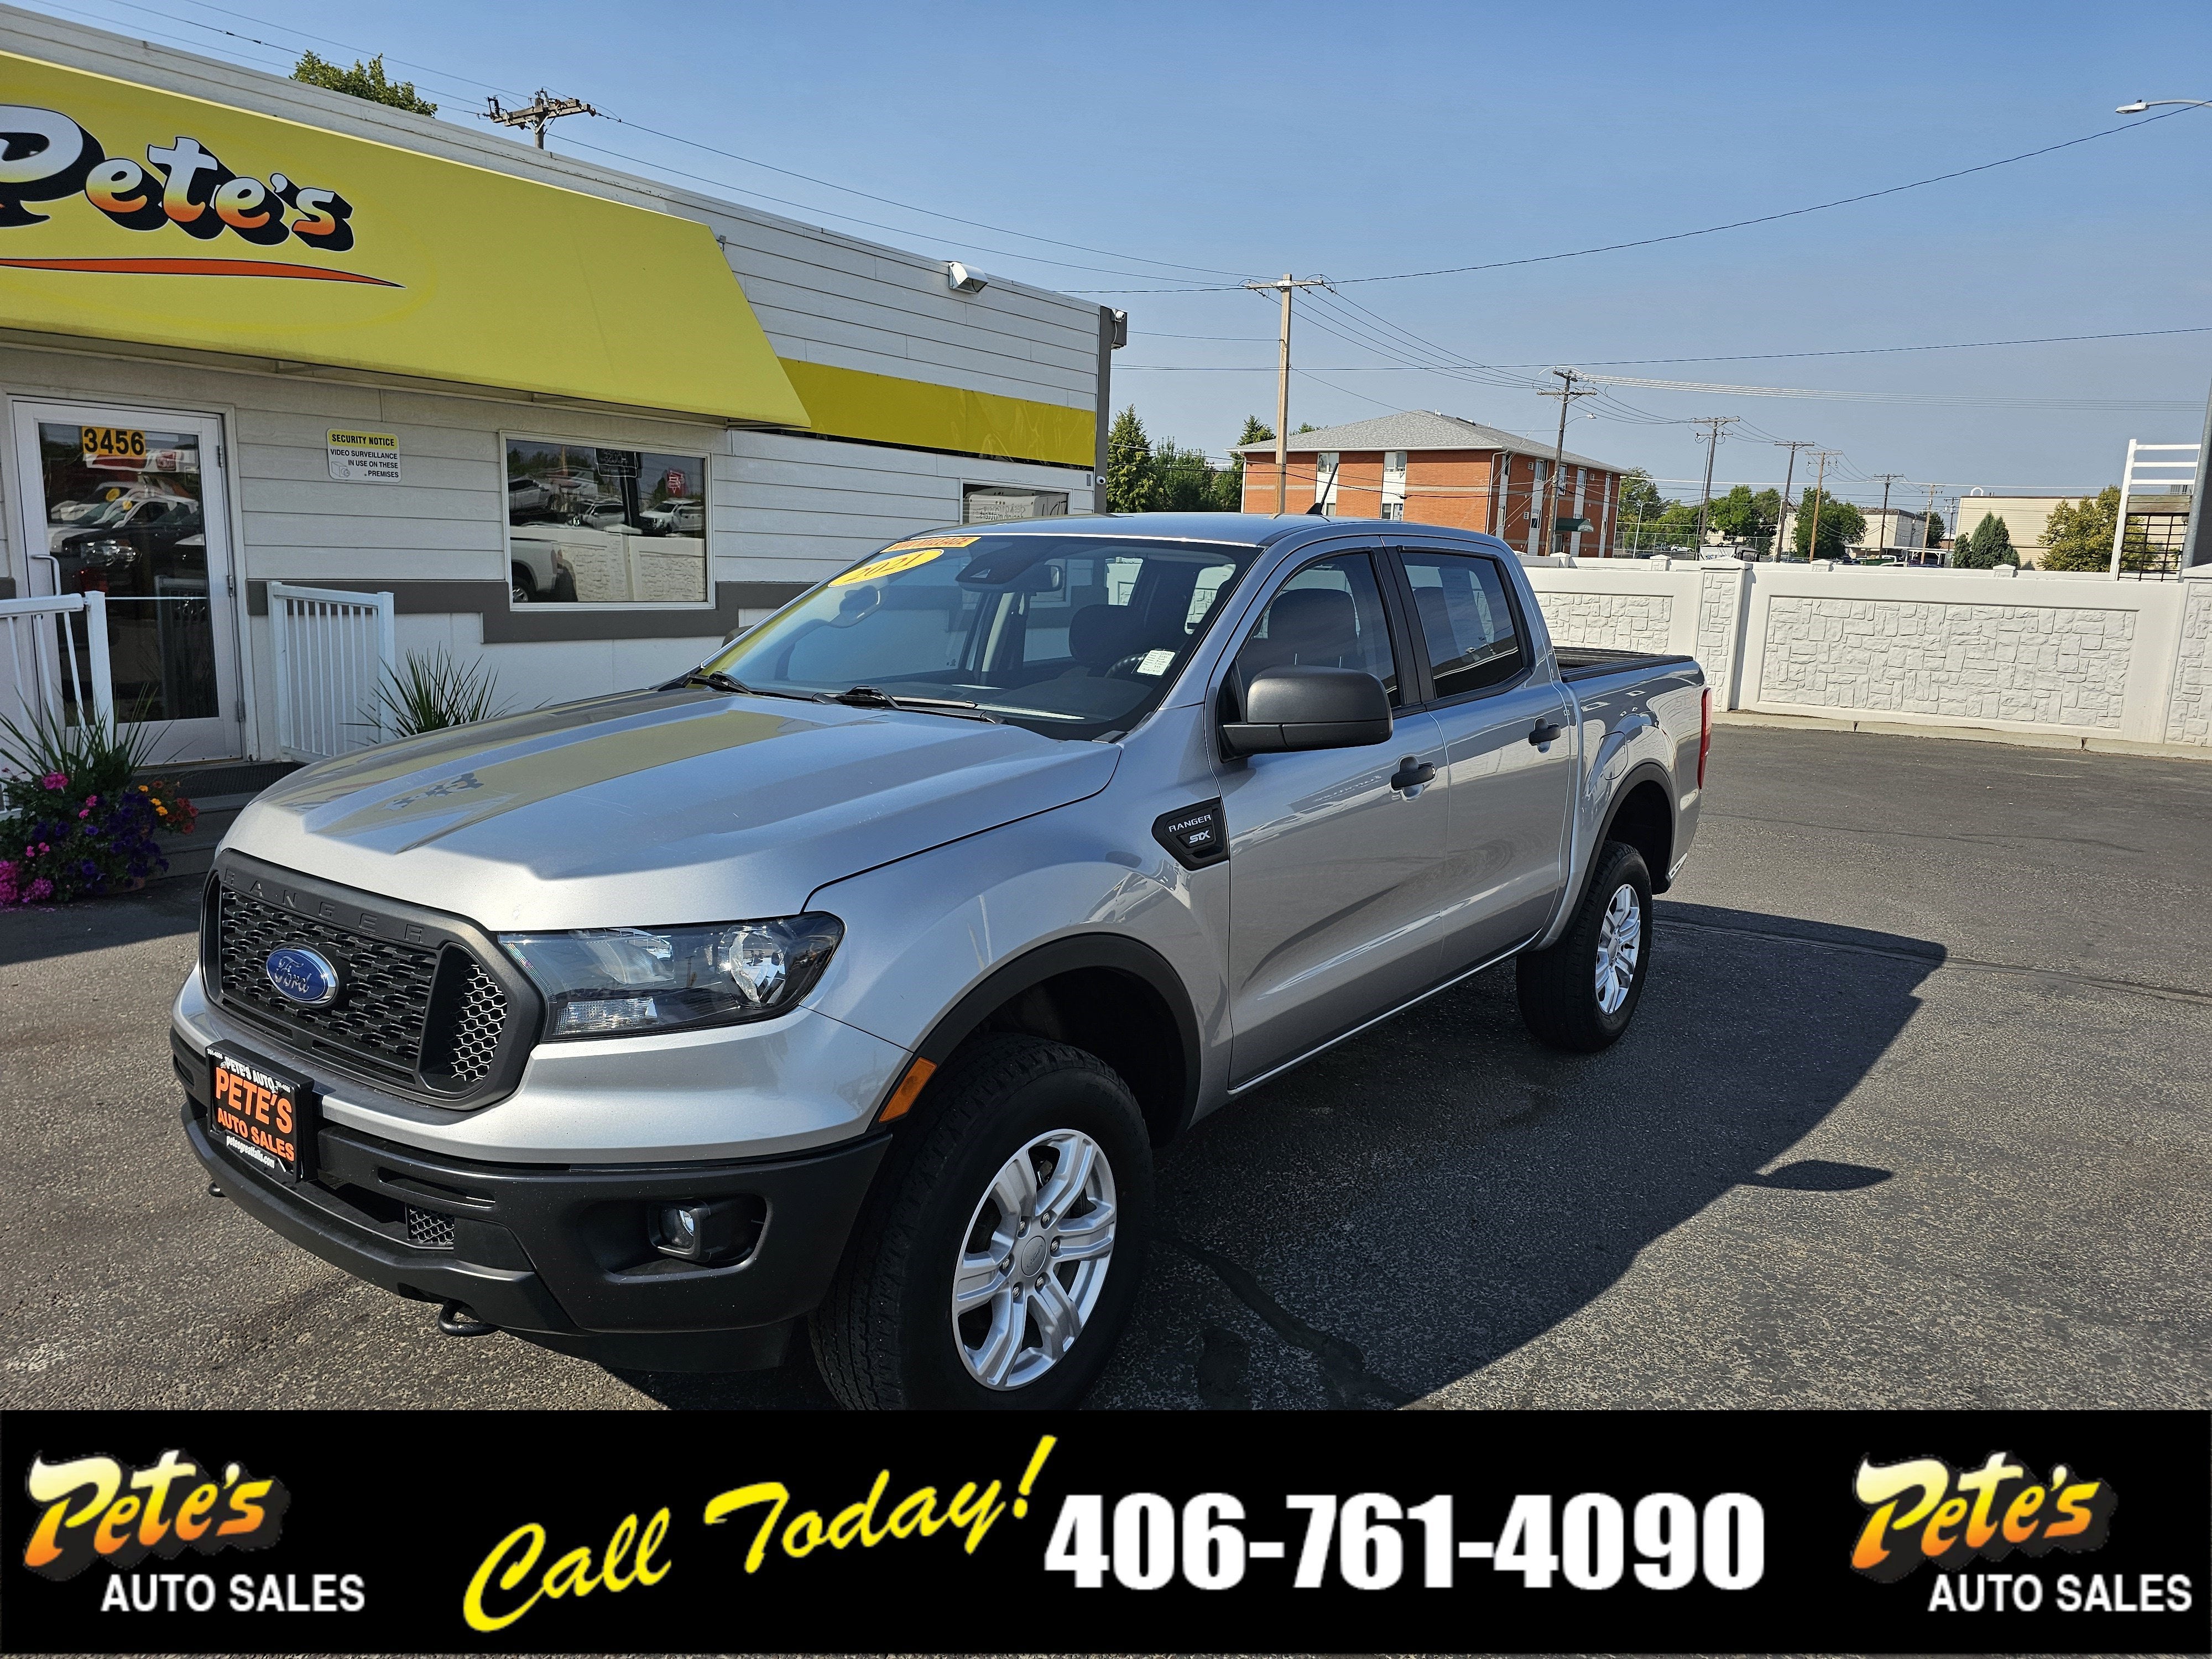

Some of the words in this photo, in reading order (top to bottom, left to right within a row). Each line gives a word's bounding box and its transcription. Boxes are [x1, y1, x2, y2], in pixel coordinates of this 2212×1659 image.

[0, 104, 354, 251] Pete's
[84, 428, 144, 455] 3456
[332, 434, 367, 444] SECURITY
[369, 437, 394, 446] NOTICE
[351, 451, 398, 460] SURVEILLANCE
[842, 552, 926, 583] 2021
[1168, 814, 1212, 832] RANGER
[1188, 830, 1211, 844] STX
[223, 868, 424, 943] RANGER
[274, 956, 312, 994] Ford
[225, 1056, 252, 1081] PETE'S
[252, 1070, 275, 1091] AUTO
[216, 1067, 293, 1134] PETE'S
[218, 1108, 248, 1138] AUTO
[251, 1126, 294, 1161] SALES
[226, 1135, 275, 1169] petesgreatfalls.com
